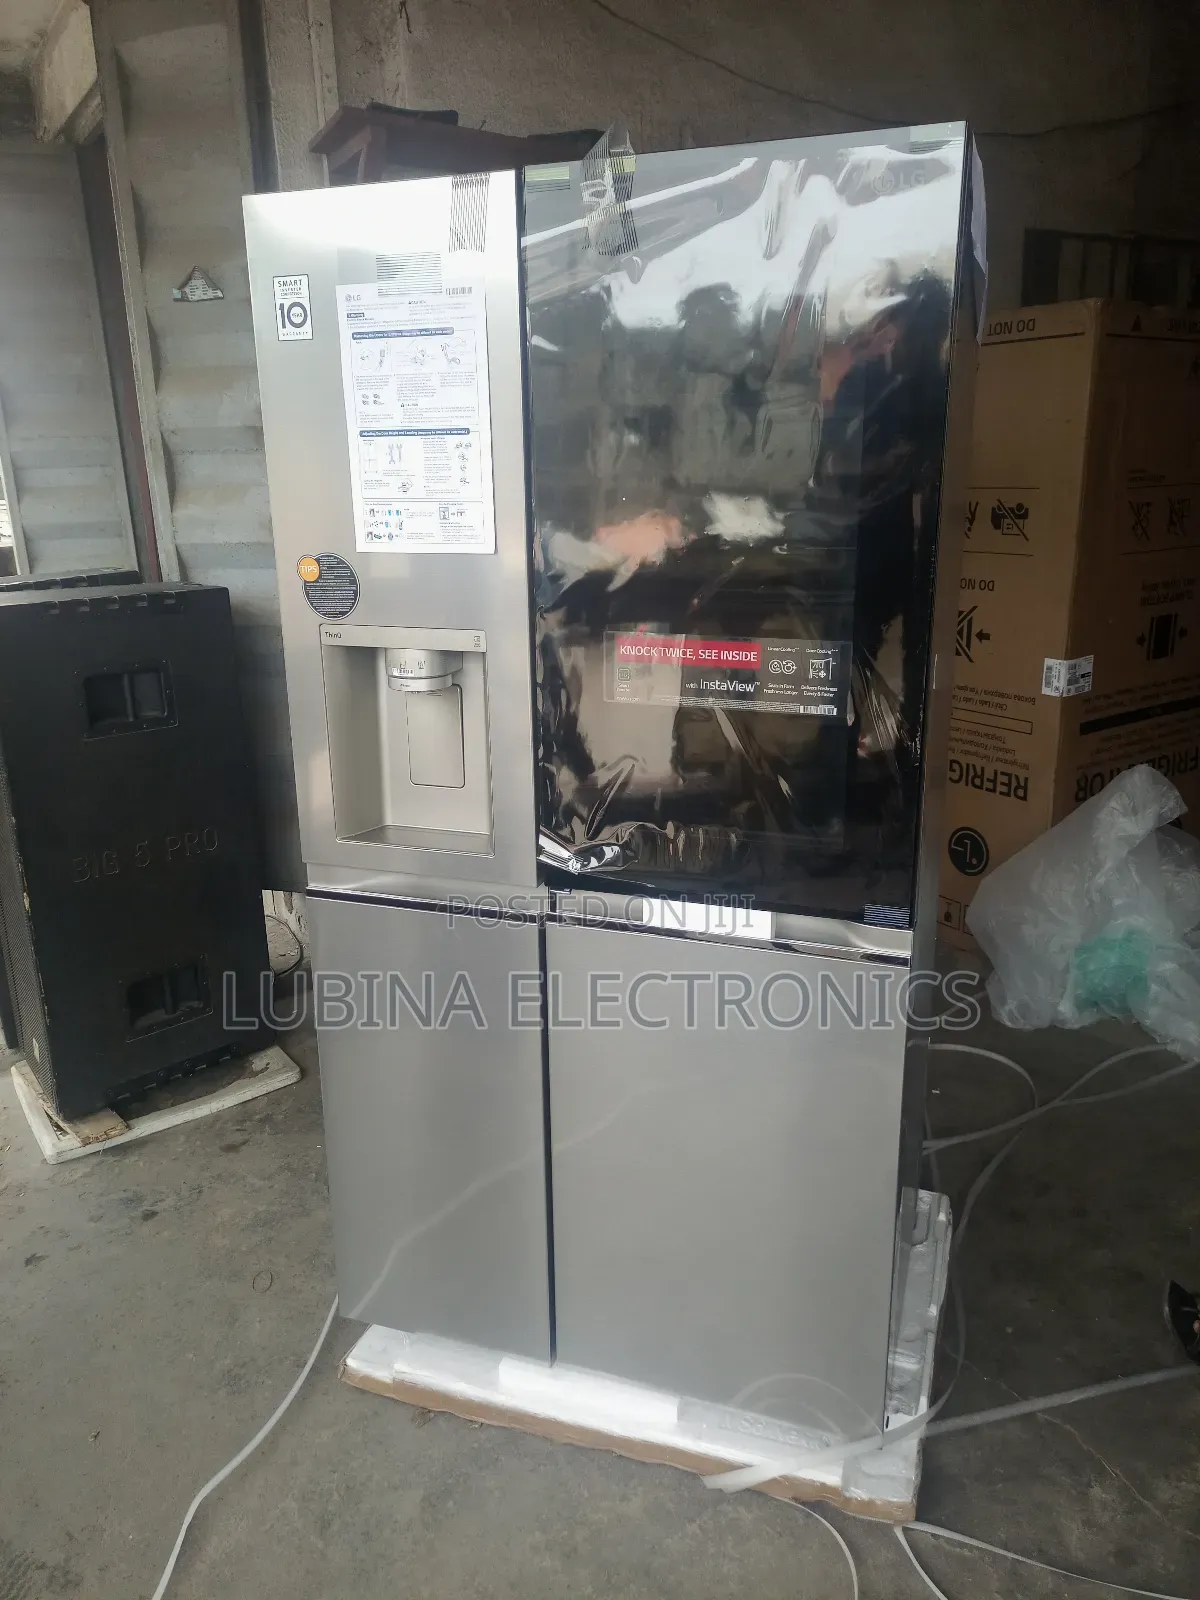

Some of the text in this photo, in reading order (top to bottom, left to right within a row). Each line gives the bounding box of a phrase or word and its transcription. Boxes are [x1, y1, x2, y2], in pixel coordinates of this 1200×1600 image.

[278, 279, 302, 287] SMART
[279, 301, 308, 329] 10
[987, 318, 1036, 336] DO NOT
[300, 565, 317, 573] TIPS
[979, 580, 995, 592] DO
[620, 645, 758, 662] KNOCK TWICE, SEE INSIDE
[71, 827, 219, 884] BIG 5 PRO
